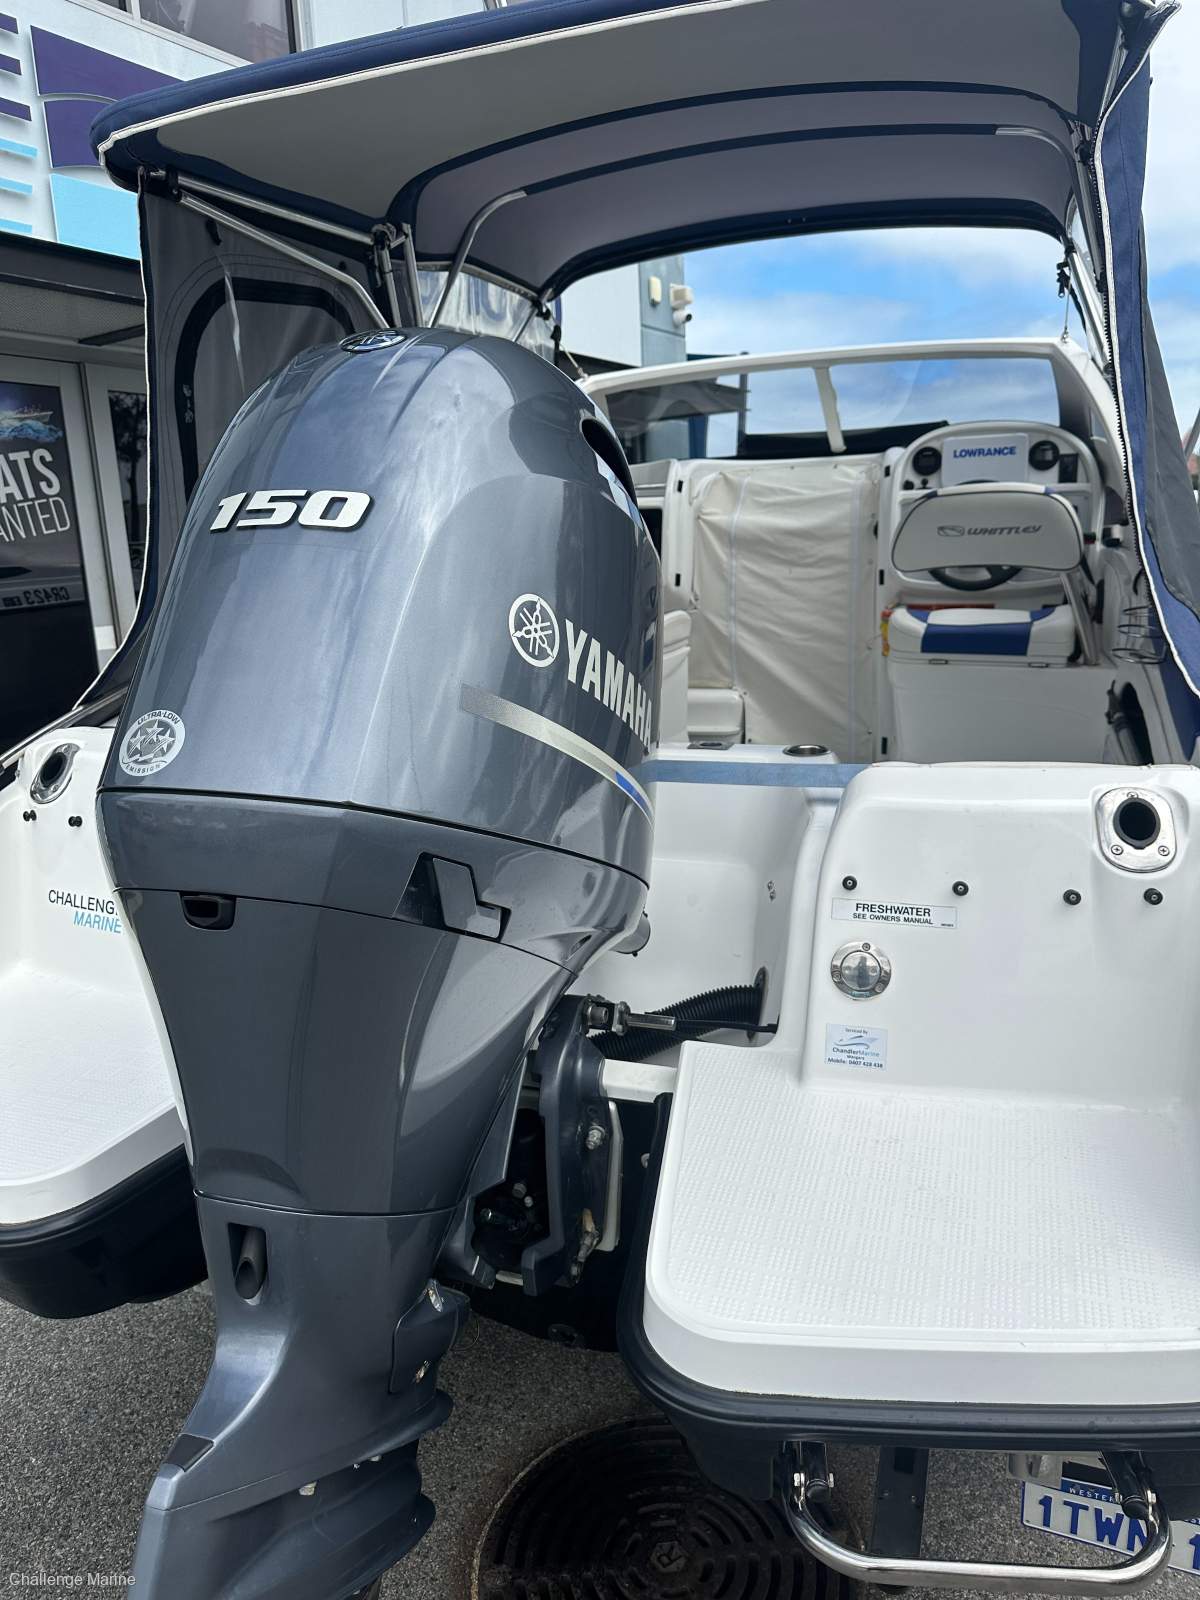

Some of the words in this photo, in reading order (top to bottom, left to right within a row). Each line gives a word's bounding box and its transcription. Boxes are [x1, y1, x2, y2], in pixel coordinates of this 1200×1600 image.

[953, 446, 1016, 459] LOWRANCE
[210, 489, 371, 531] 150
[967, 525, 1042, 536] WHITTLEY
[565, 618, 652, 754] YAMAHA
[48, 889, 118, 916] CHALLENG
[855, 902, 931, 918] FRESHWATER
[73, 910, 122, 934] MARINE
[852, 912, 868, 920] SEE
[869, 913, 901, 923] OWNERS
[903, 916, 933, 925] MANUAL
